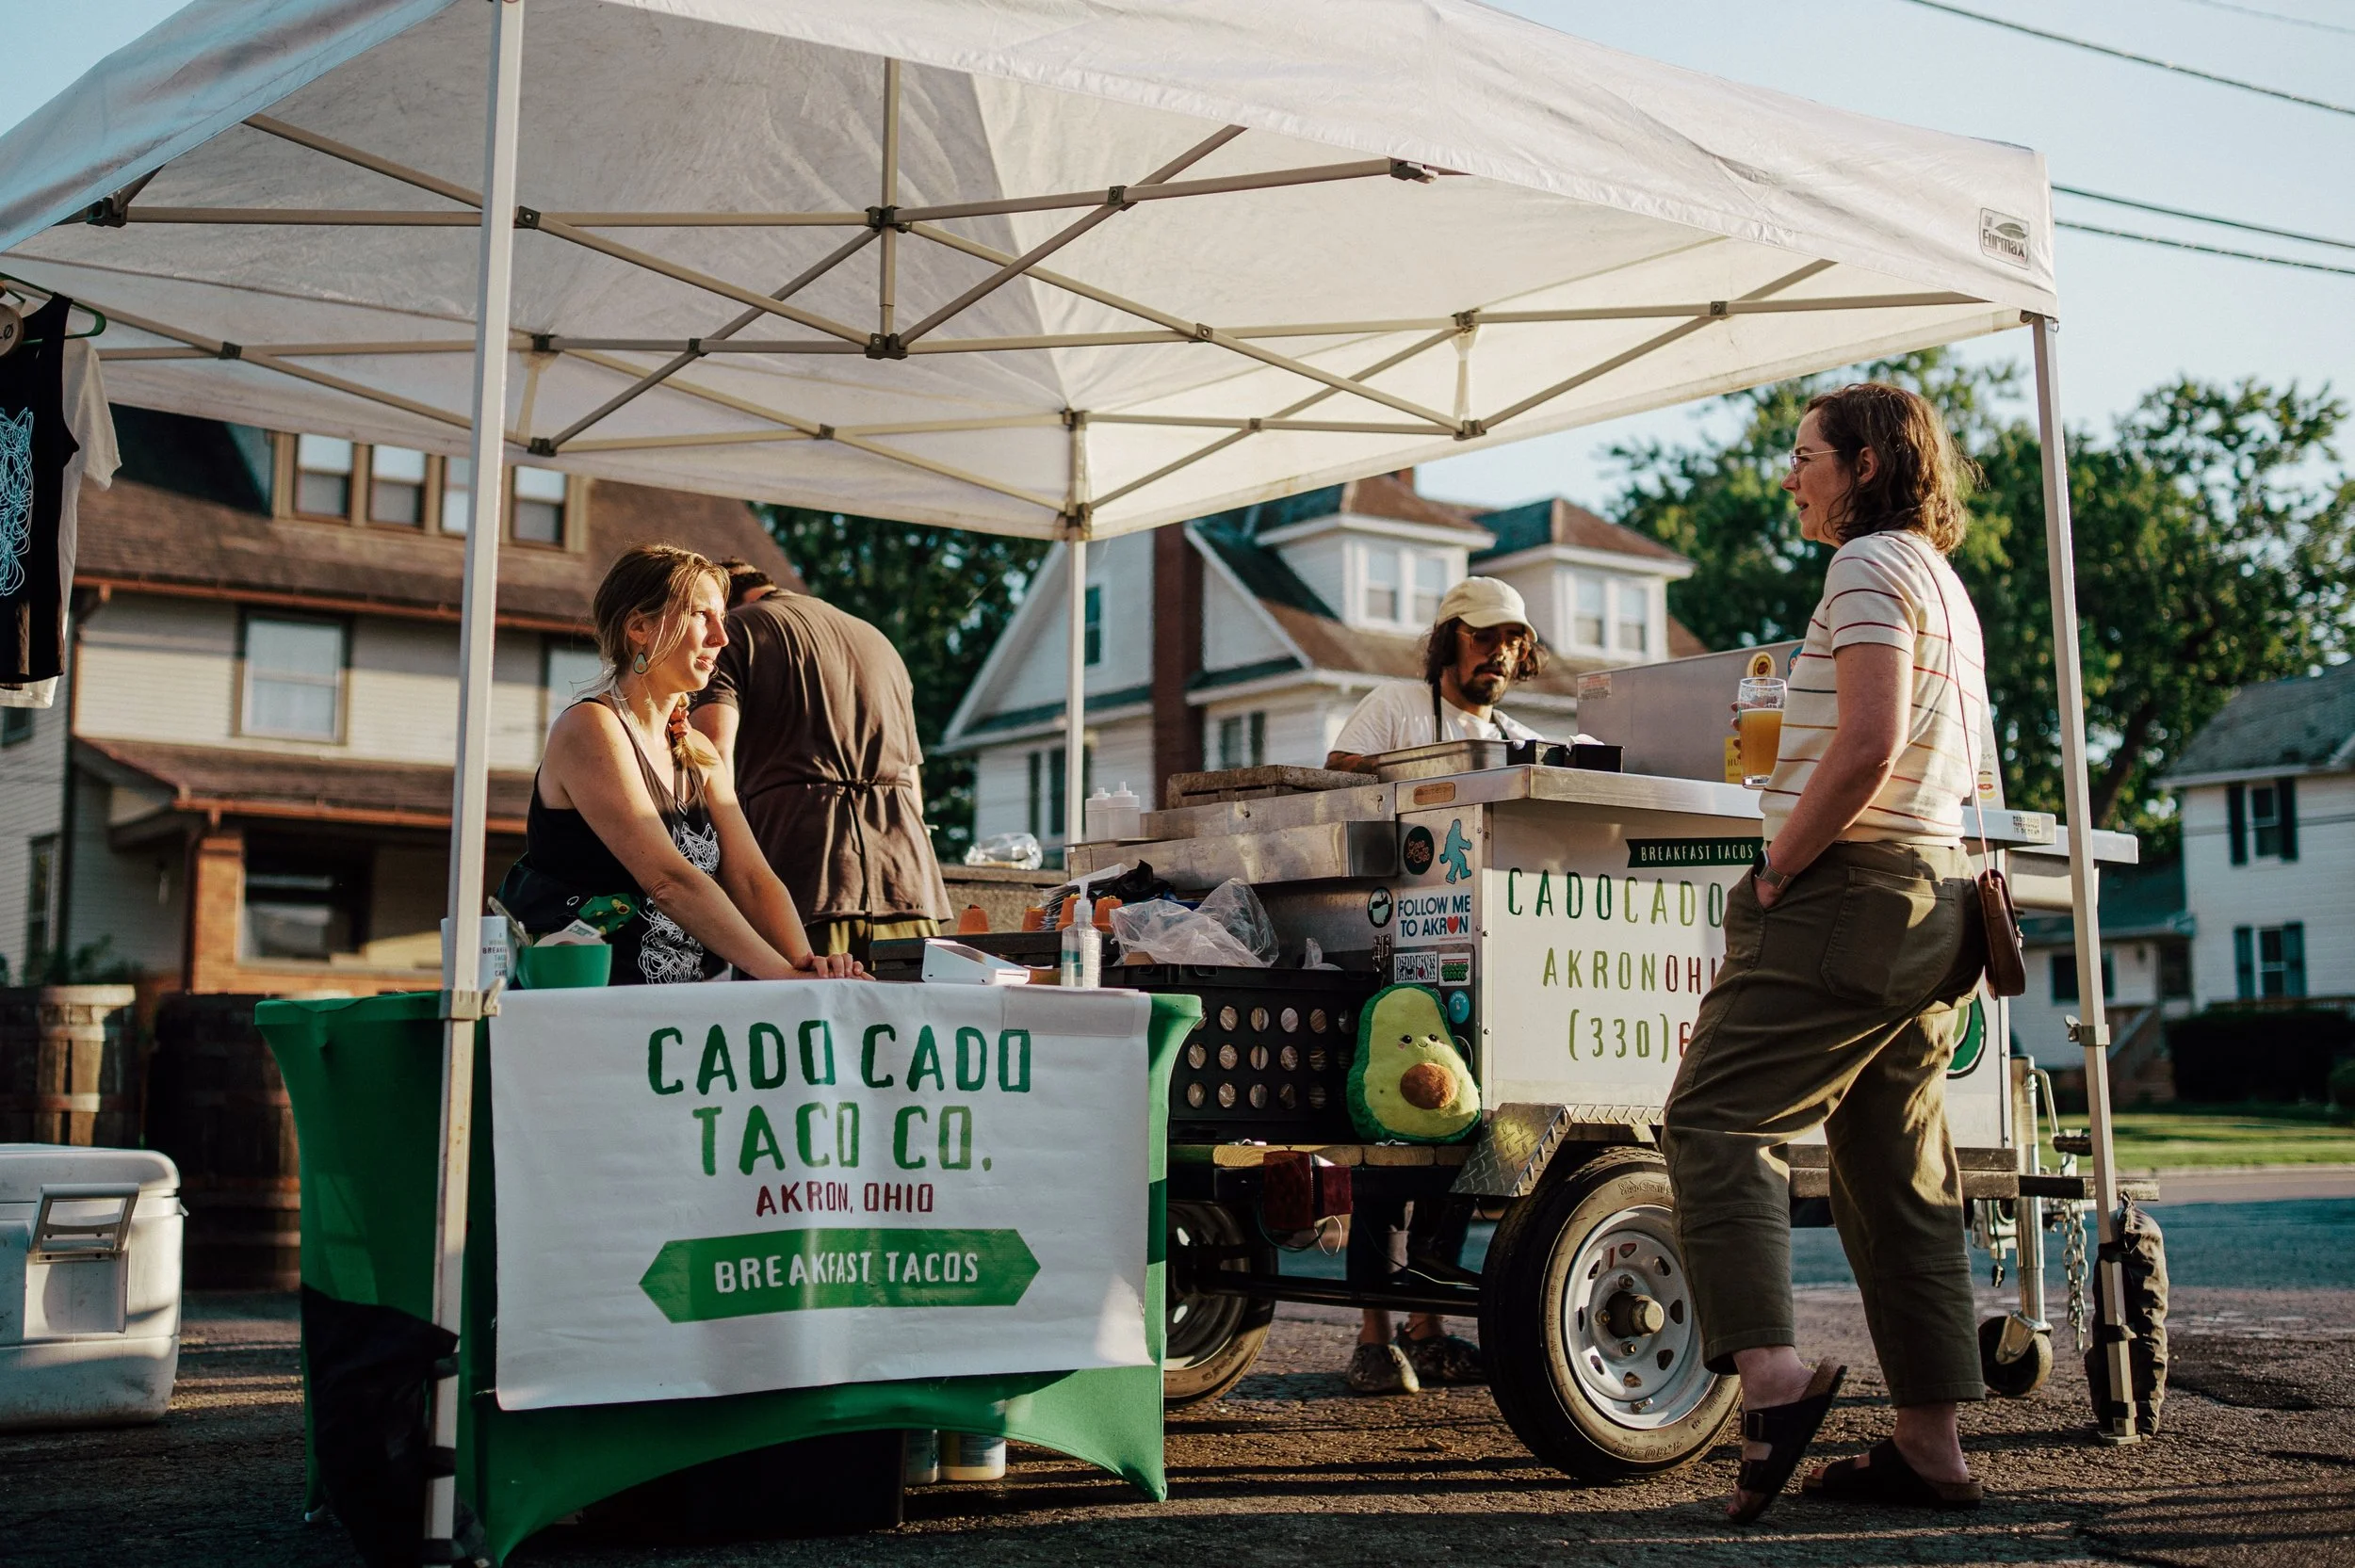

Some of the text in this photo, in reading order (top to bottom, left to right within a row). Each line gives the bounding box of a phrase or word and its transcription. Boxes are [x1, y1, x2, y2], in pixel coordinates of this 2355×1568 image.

[1641, 844, 1753, 862] BREAKFAST TACOS
[1397, 895, 1471, 918] FOLLOW ME
[1507, 867, 1723, 928] CADOCADO
[1400, 919, 1418, 938] TO
[647, 1020, 1031, 1095] CADO CADO
[691, 1102, 992, 1176] TACO CO.
[755, 1180, 934, 1218] AKRON, OHIO
[714, 1252, 979, 1293] BREAKFAST TACOS
